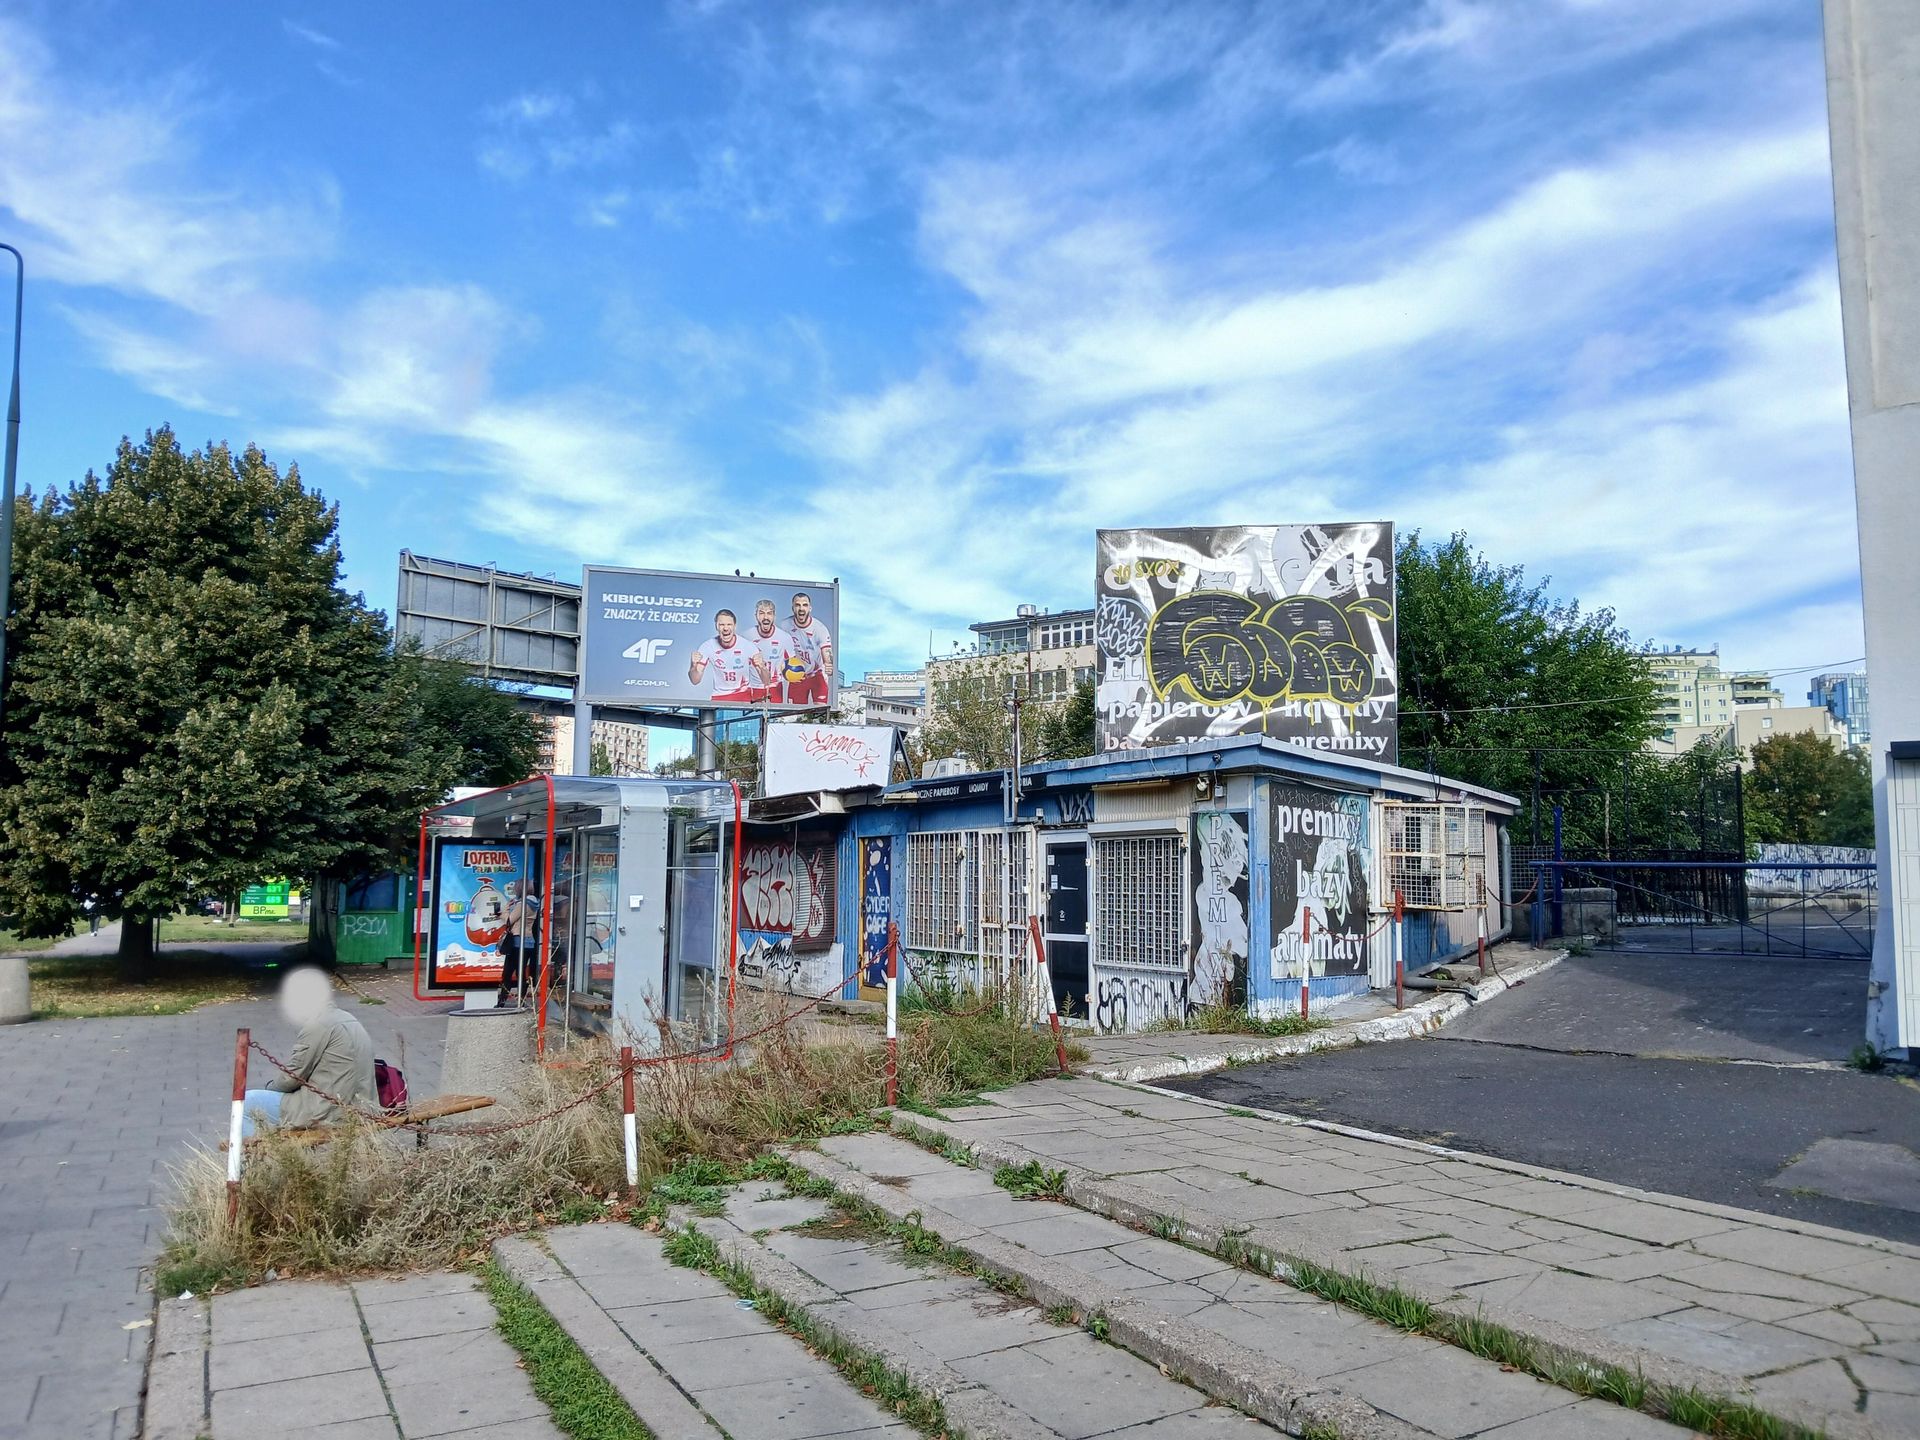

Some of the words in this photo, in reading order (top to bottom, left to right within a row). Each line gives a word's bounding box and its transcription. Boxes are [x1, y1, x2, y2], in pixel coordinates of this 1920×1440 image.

[602, 593, 703, 608] KIBICUJESZ?
[603, 608, 645, 622] ZNACZY,
[647, 609, 661, 622] ŻE
[662, 612, 700, 624] CHCESZ
[622, 638, 674, 664] 4F
[623, 679, 671, 687] 4F.COM.PL
[1277, 802, 1362, 852] premixy
[1296, 859, 1348, 910] bazy
